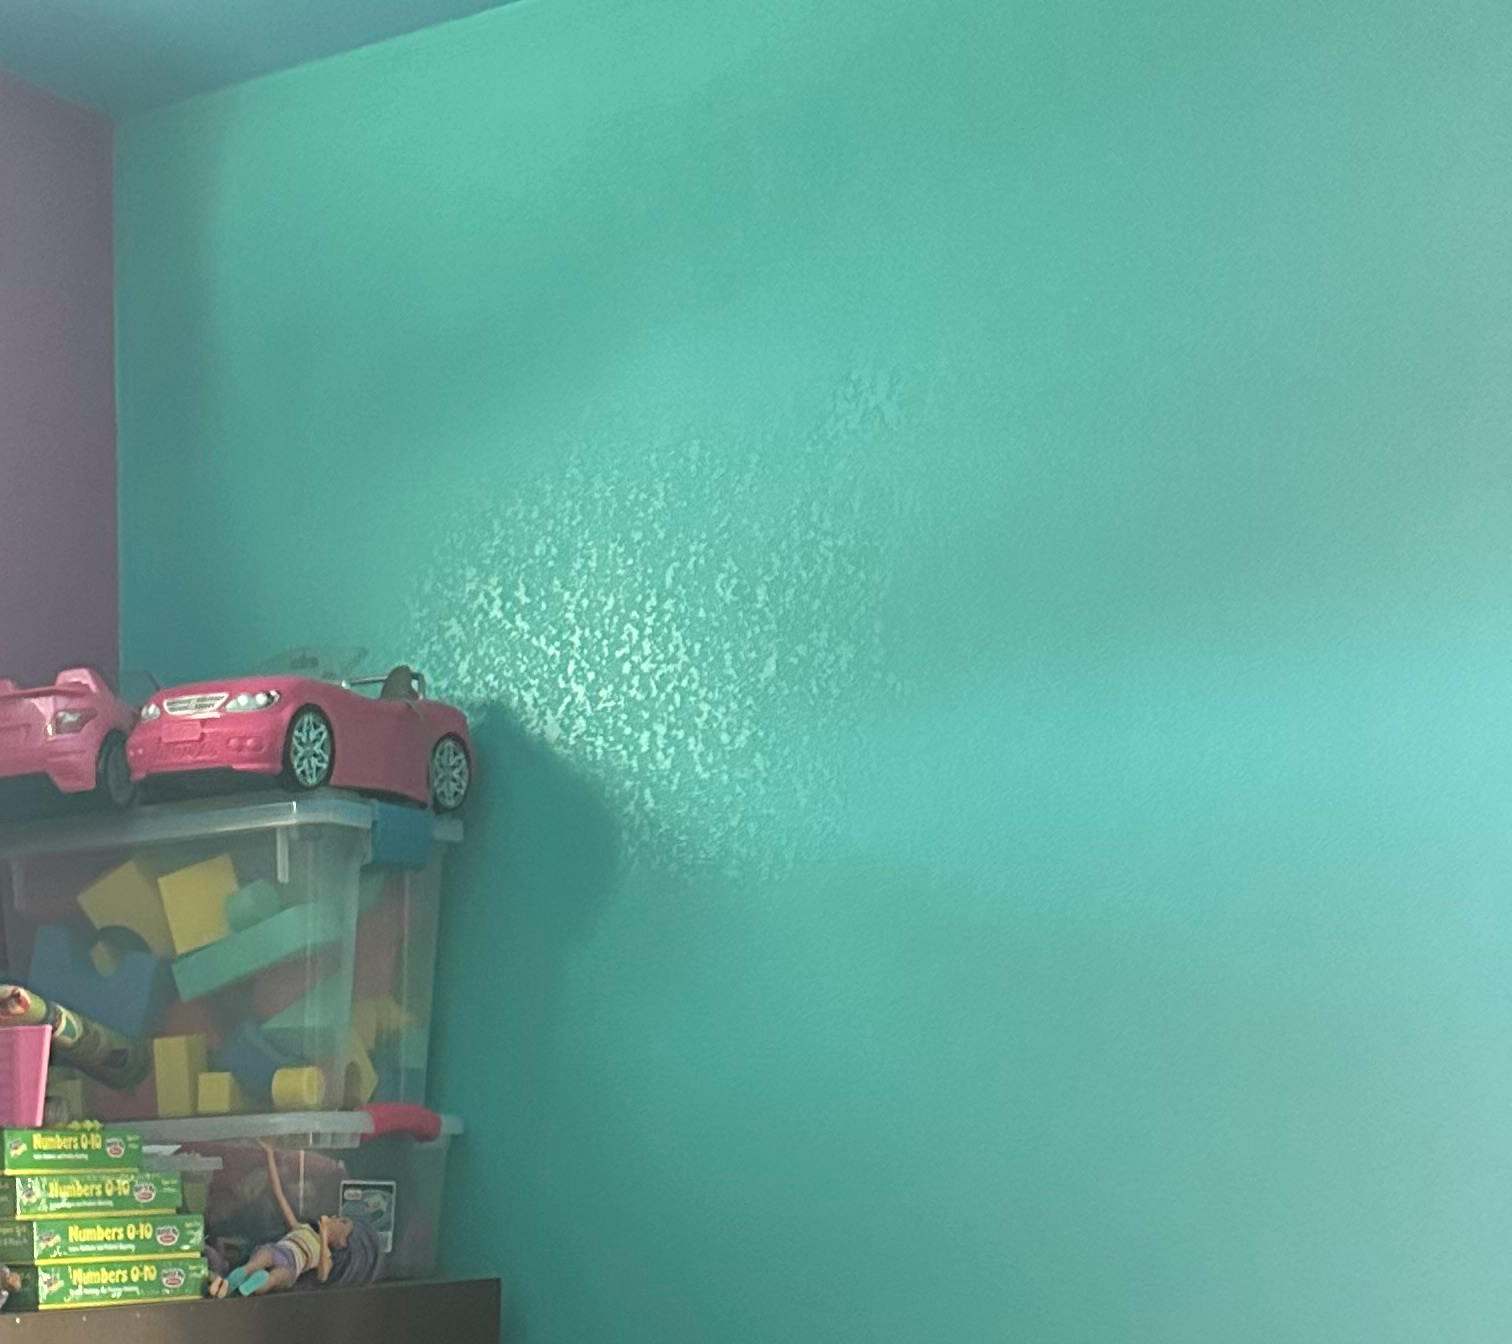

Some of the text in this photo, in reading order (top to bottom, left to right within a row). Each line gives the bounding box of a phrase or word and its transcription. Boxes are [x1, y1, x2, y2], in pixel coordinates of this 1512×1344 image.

[32, 1133, 78, 1150] Numbers
[81, 1132, 102, 1150] 0-10
[48, 1180, 102, 1198] Numbers
[105, 1179, 130, 1197] 0-10
[68, 1224, 124, 1242] Numbers
[126, 1222, 153, 1240] 0-10
[72, 1267, 128, 1285] Numbers
[130, 1264, 157, 1282] 0-10
